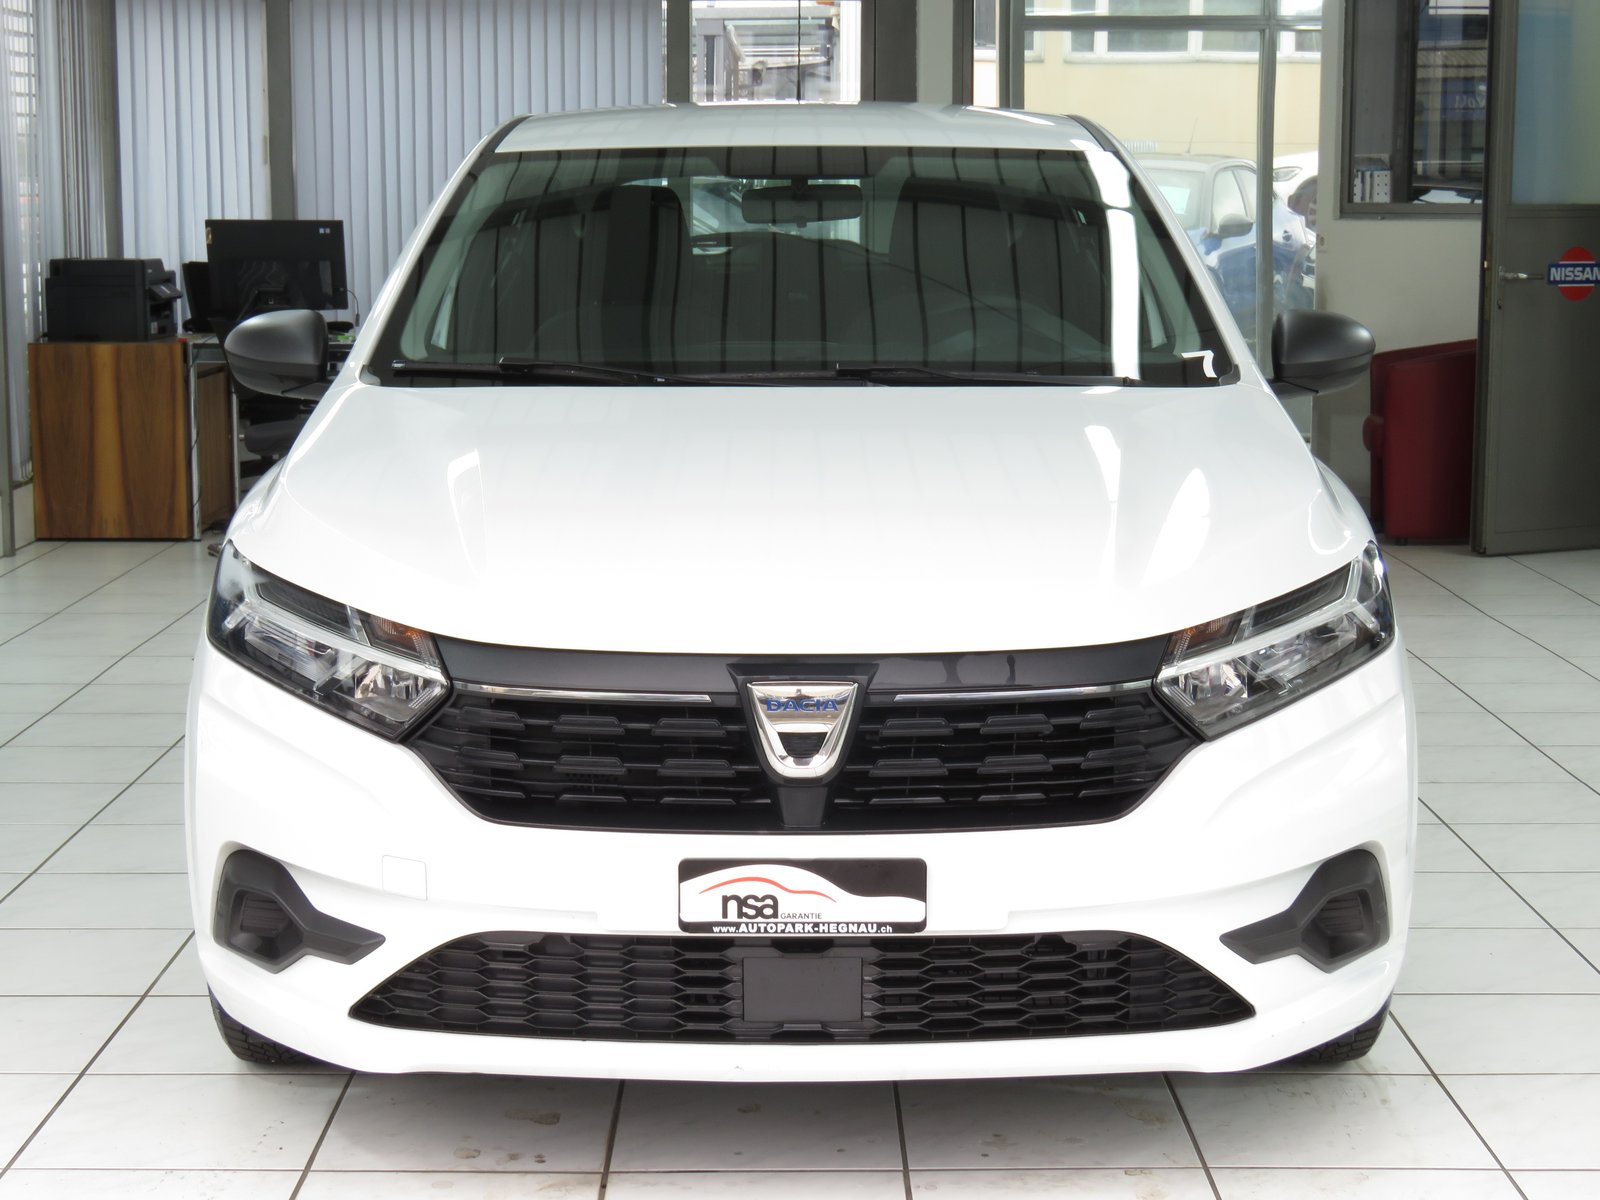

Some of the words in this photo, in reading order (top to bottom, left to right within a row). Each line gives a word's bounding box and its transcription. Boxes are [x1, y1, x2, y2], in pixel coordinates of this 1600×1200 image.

[1549, 267, 1600, 281] NISSAN
[766, 698, 839, 712] DACIA
[721, 894, 779, 920] nsa
[780, 912, 822, 920] GARANTIE
[712, 923, 893, 934] www.AUTOPARK-HEGNAU.ch
